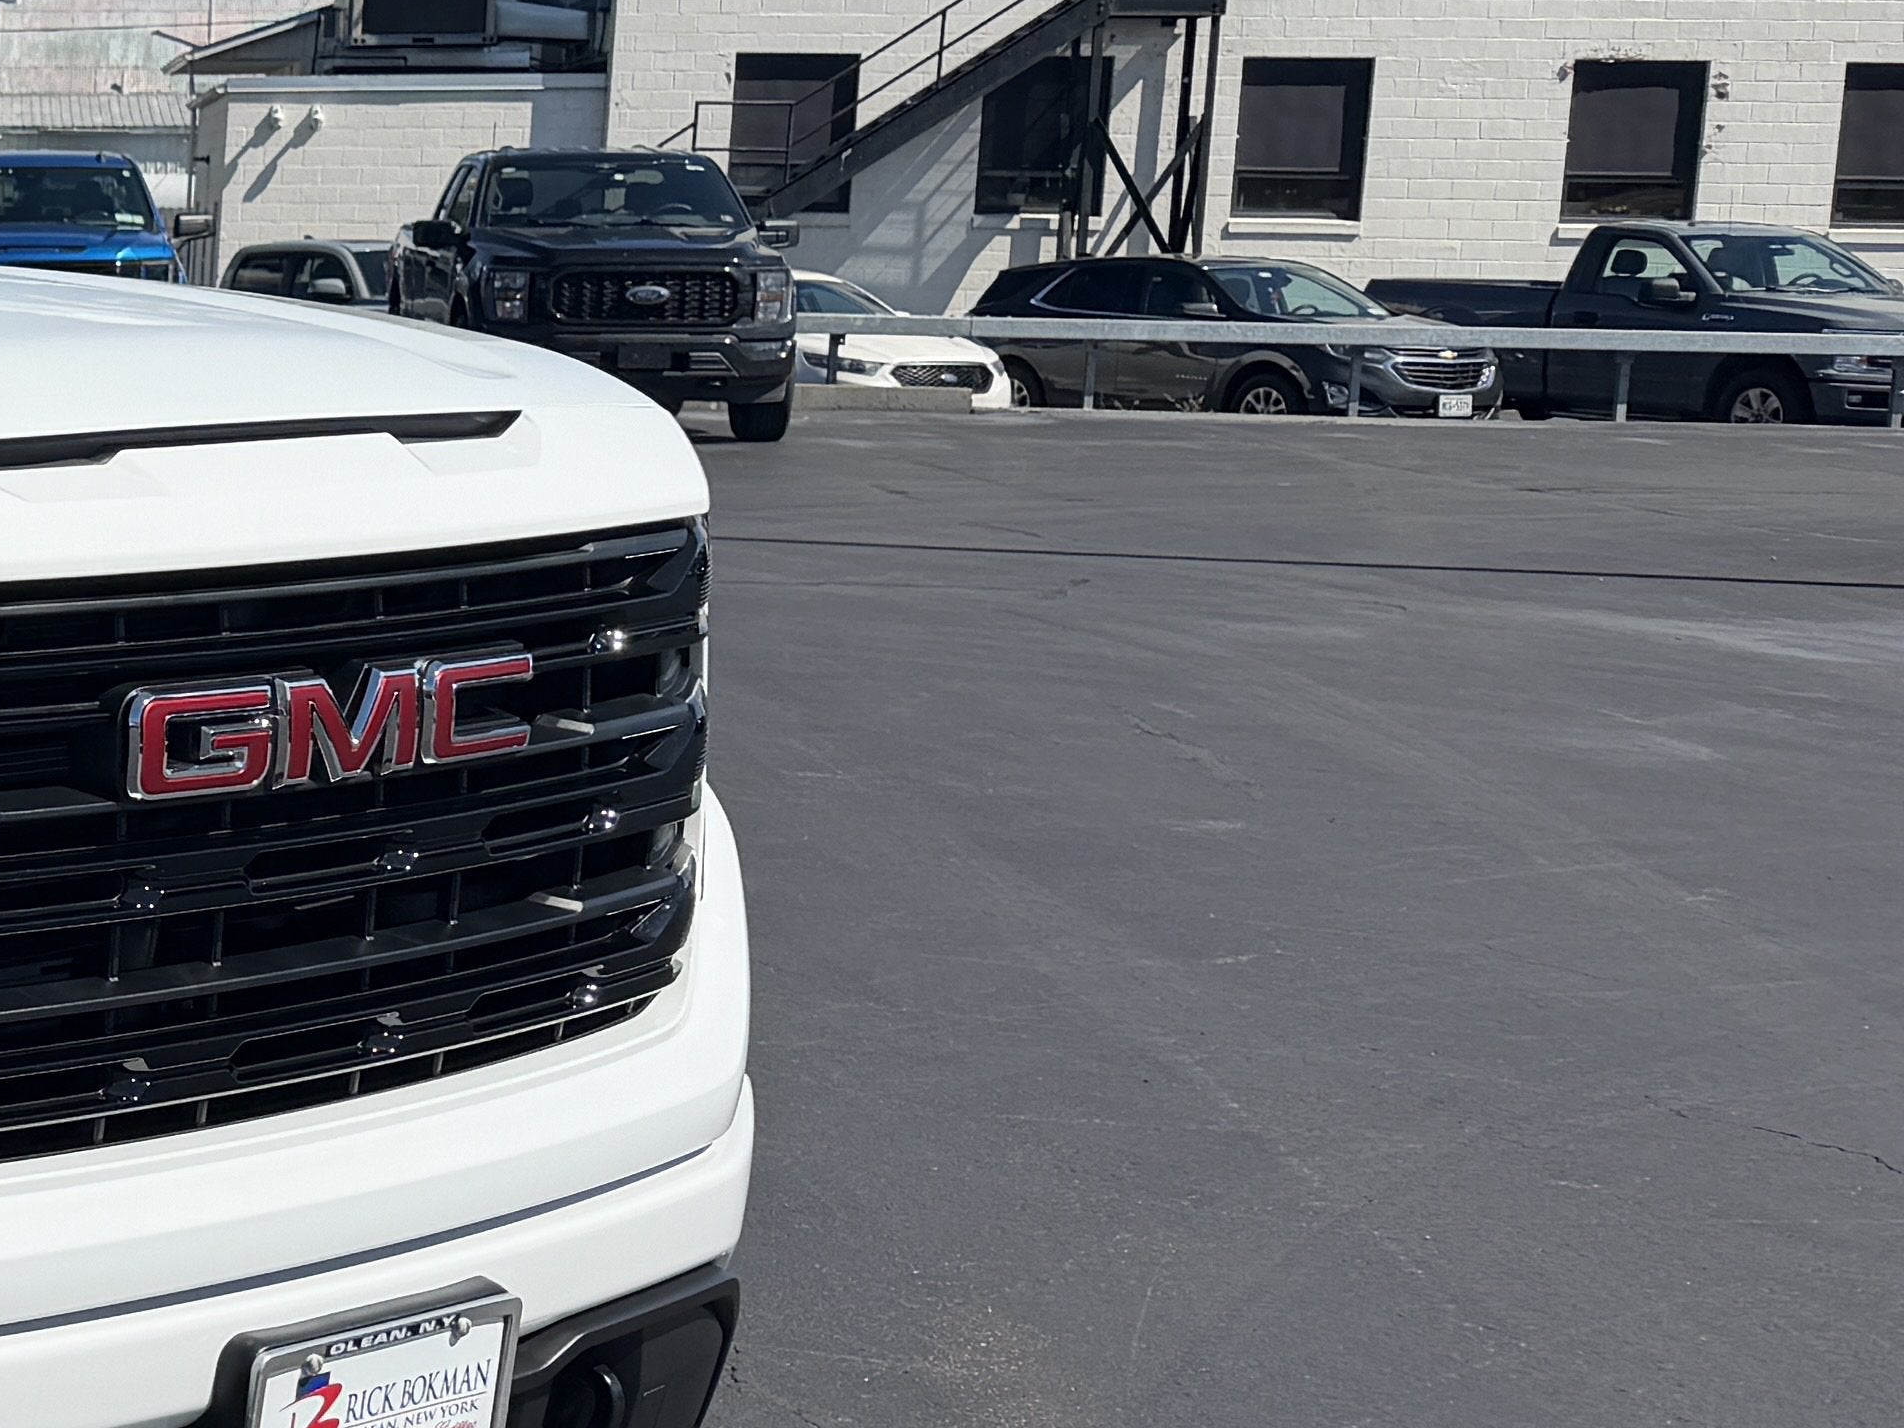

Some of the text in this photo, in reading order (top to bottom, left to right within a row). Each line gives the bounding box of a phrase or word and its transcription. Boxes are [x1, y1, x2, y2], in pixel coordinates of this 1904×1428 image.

[126, 651, 534, 802] GMC
[345, 1358, 491, 1424] RICK BOKMAN
[404, 1408, 437, 1427] NEW
[440, 1397, 480, 1419] YORK
